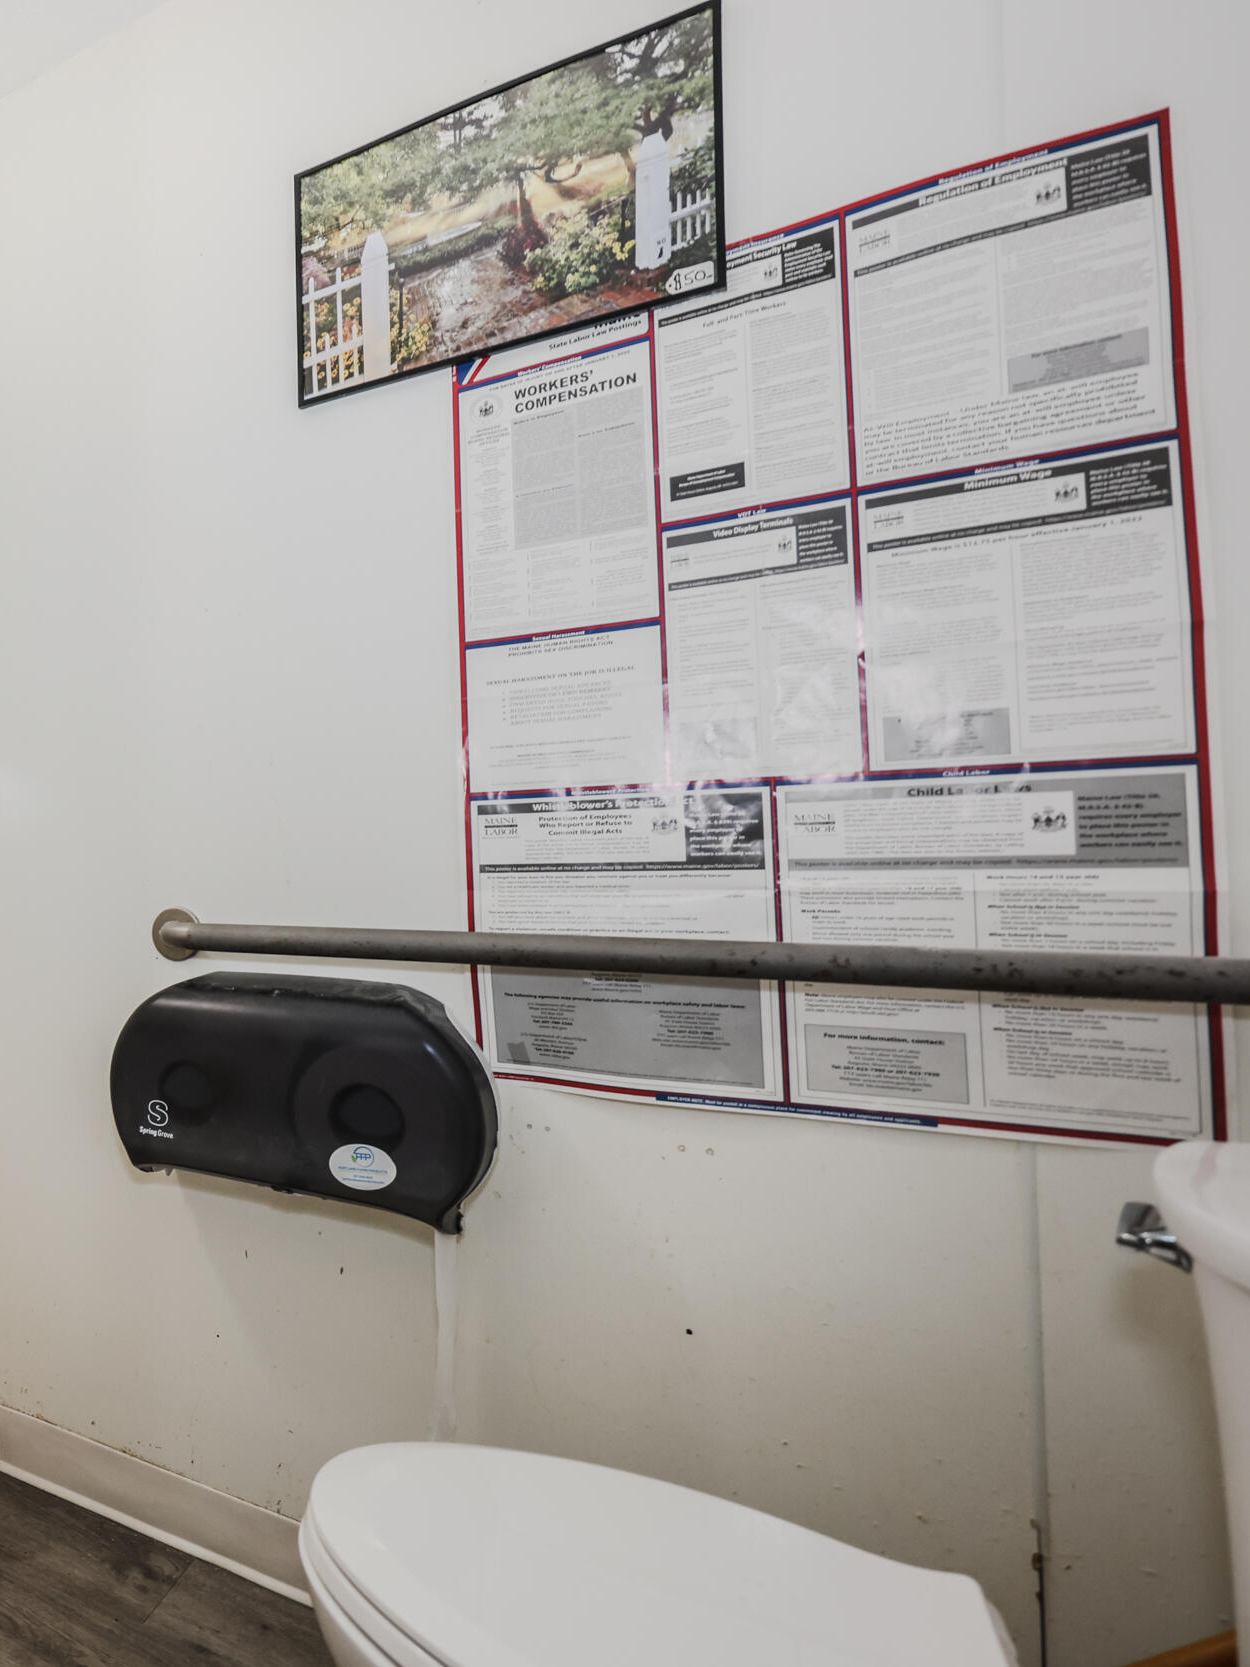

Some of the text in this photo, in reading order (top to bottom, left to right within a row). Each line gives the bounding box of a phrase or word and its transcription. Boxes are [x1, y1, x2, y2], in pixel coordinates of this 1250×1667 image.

[919, 157, 1068, 207] Regulation of Employment
[753, 244, 782, 260] Security
[782, 241, 798, 252] Law
[549, 340, 568, 350] State
[569, 333, 591, 345] Labor
[592, 329, 608, 338] Law
[609, 319, 642, 334] Postings
[514, 369, 593, 400] WORKERS'
[515, 372, 637, 414] COMPENSATION
[964, 469, 1052, 491] Minimum Wage
[713, 517, 794, 538] Video Display Terminals
[907, 784, 1032, 797] Child Laor Lws
[532, 797, 670, 813] Whistblower's Potectio
[485, 816, 517, 824] MAINE
[538, 815, 578, 823] Protection
[590, 812, 632, 822] Employees
[557, 821, 584, 829] Report
[595, 819, 622, 827] Refuse
[485, 828, 518, 836] LABOR
[548, 827, 623, 837] Commit Illegal Acts
[859, 1034, 909, 1044] information,
[139, 1125, 174, 1139] Spring Grove
